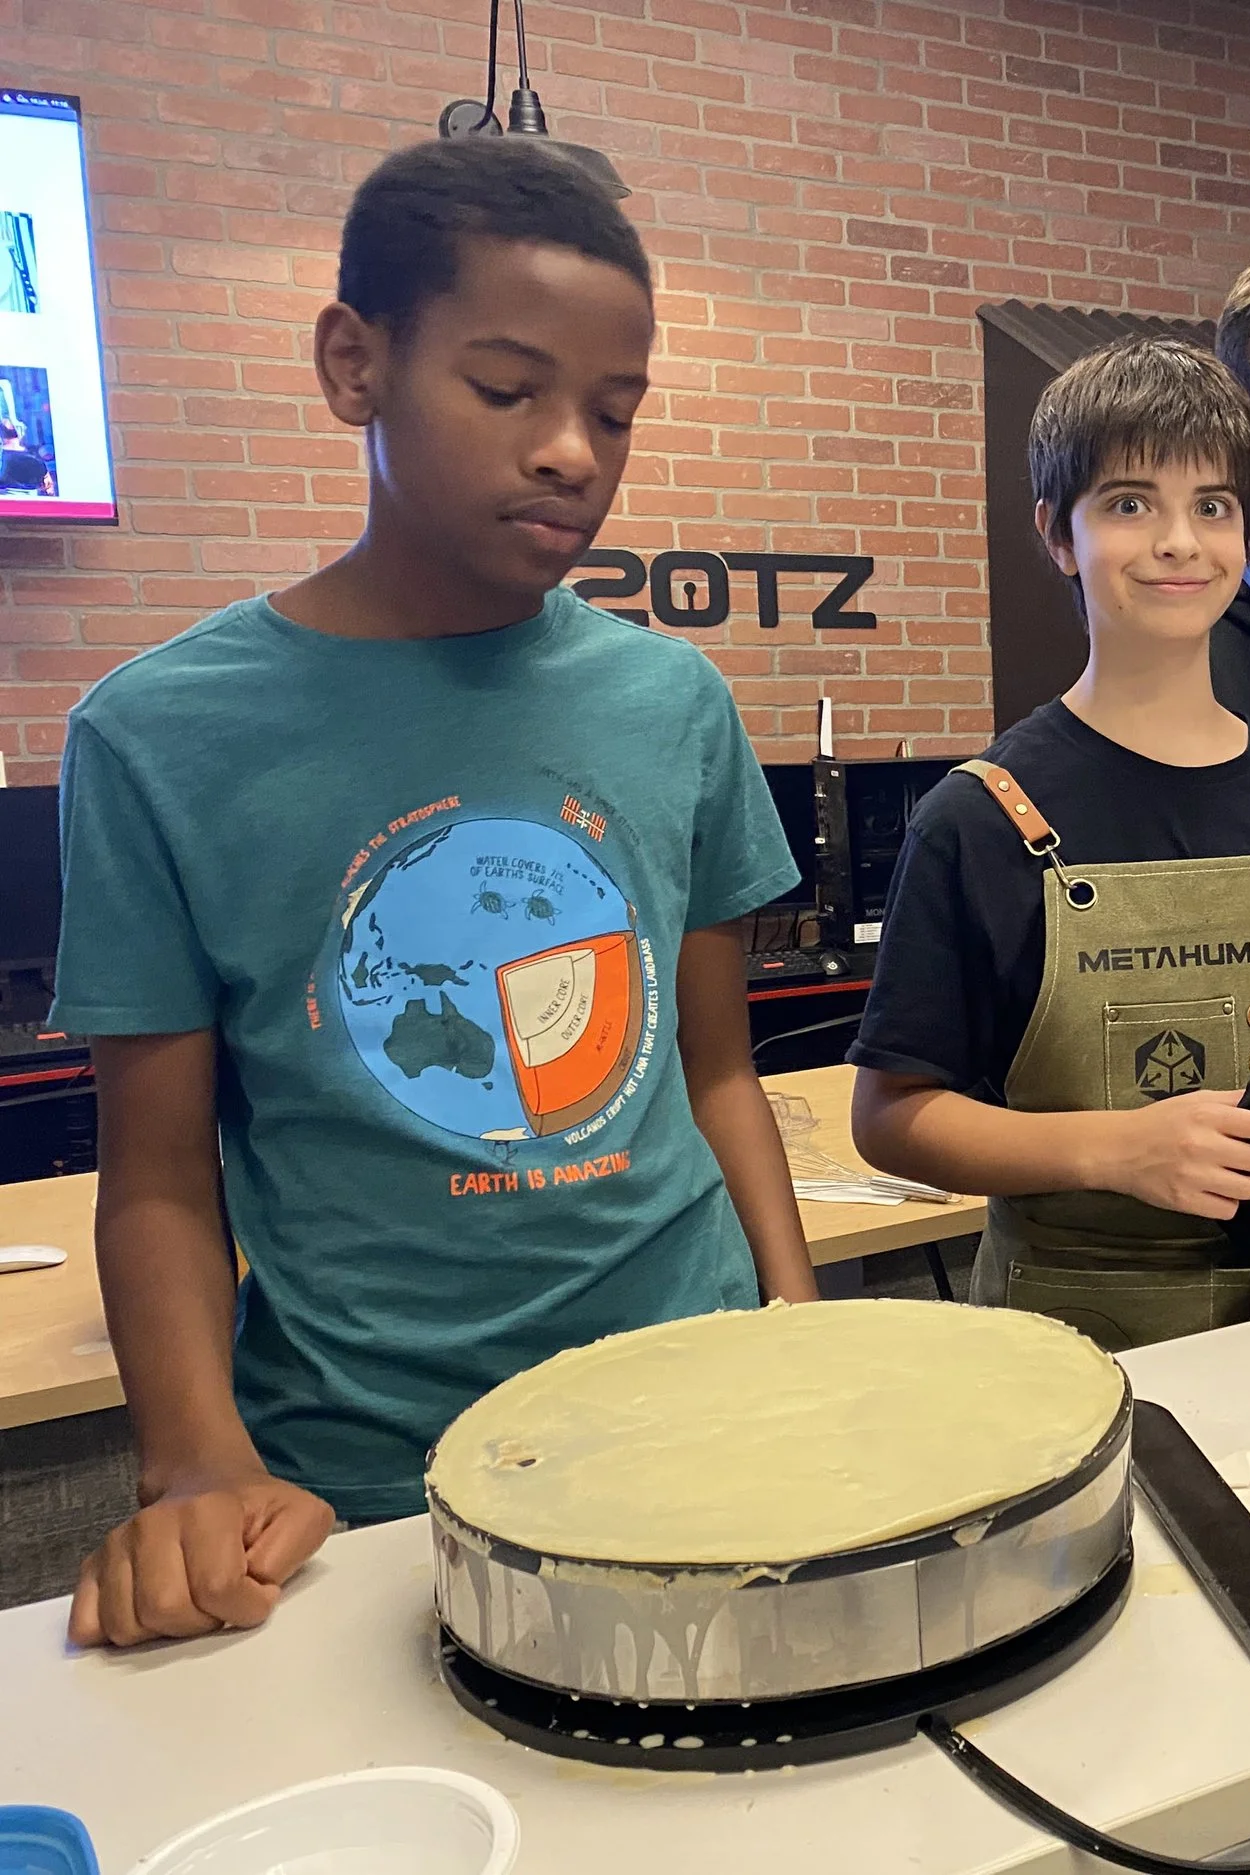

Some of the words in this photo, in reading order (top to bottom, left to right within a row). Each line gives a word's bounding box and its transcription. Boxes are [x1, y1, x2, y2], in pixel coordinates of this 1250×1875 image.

[469, 866, 482, 877] OF
[476, 855, 509, 867] WATER
[511, 857, 546, 875] COVERS
[640, 938, 658, 987] LANDMASS
[537, 1000, 562, 1024] INNER
[555, 978, 570, 1002] CORE
[647, 990, 658, 1030] CREATES
[560, 1014, 581, 1041] OUTER
[577, 993, 589, 1015] CORE
[641, 1030, 656, 1055] THAT
[633, 1056, 650, 1079] LAVA
[622, 1078, 638, 1097] HOT
[605, 1095, 626, 1120] ERUPT
[450, 1170, 519, 1197] EARTH
[527, 1168, 546, 1190] IS
